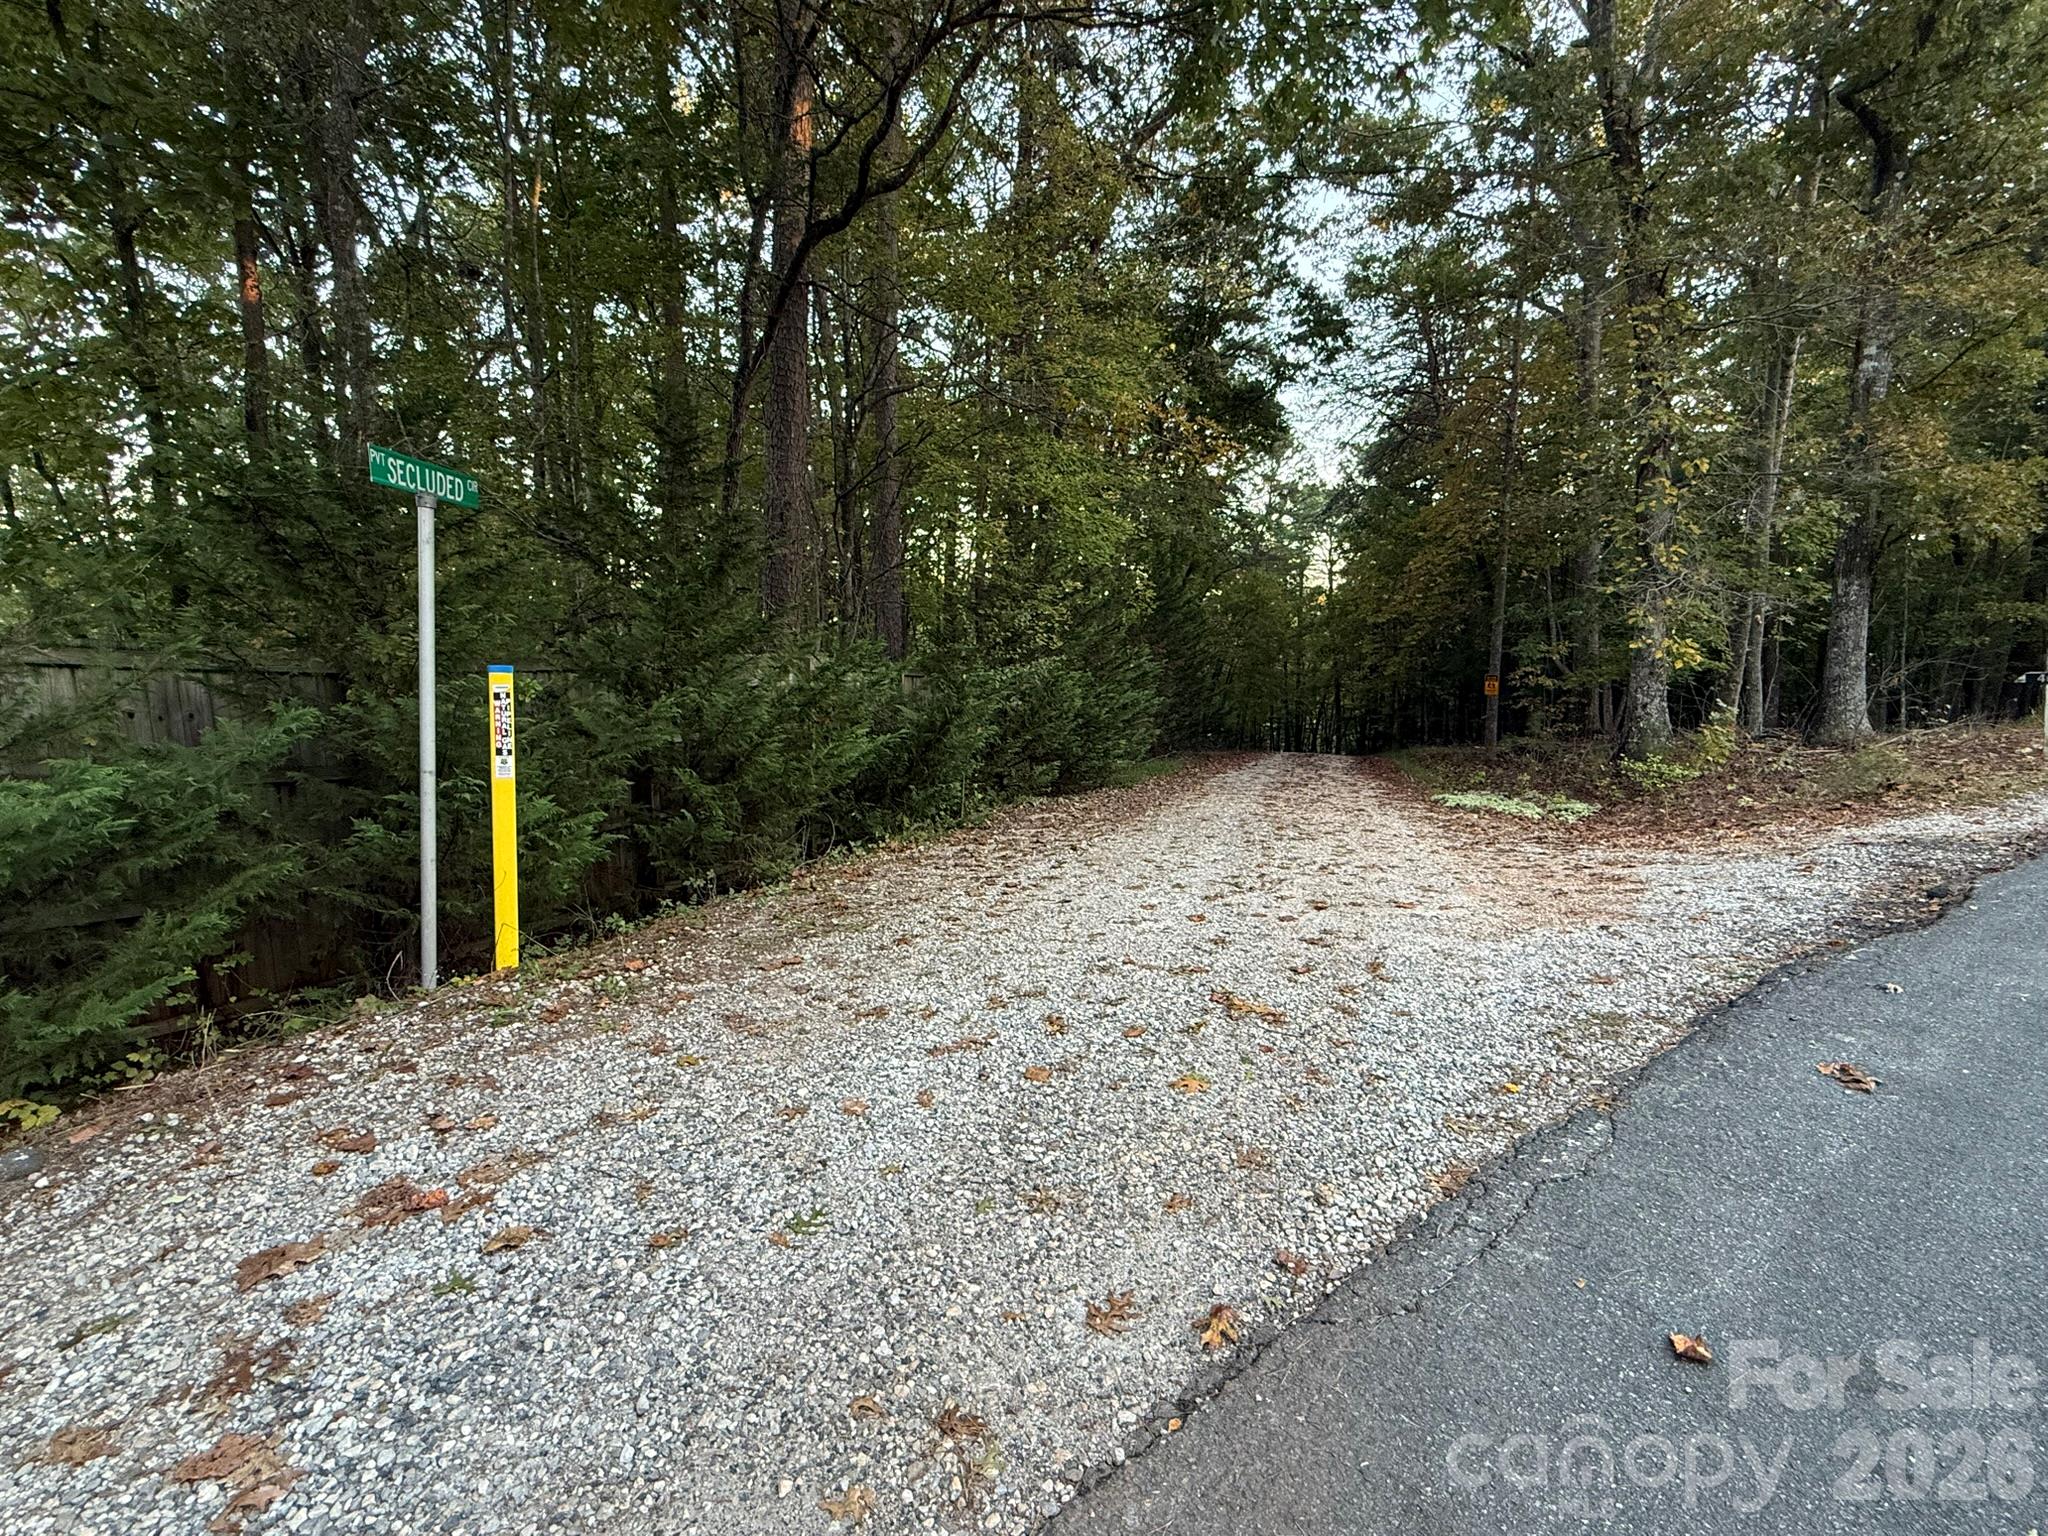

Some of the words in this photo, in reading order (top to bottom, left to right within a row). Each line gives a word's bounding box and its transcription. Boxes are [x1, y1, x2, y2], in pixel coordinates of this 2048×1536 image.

[370, 448, 385, 466] PVT
[387, 456, 464, 502] SECLUDED
[467, 479, 479, 493] CIR
[494, 700, 503, 748] WARNING
